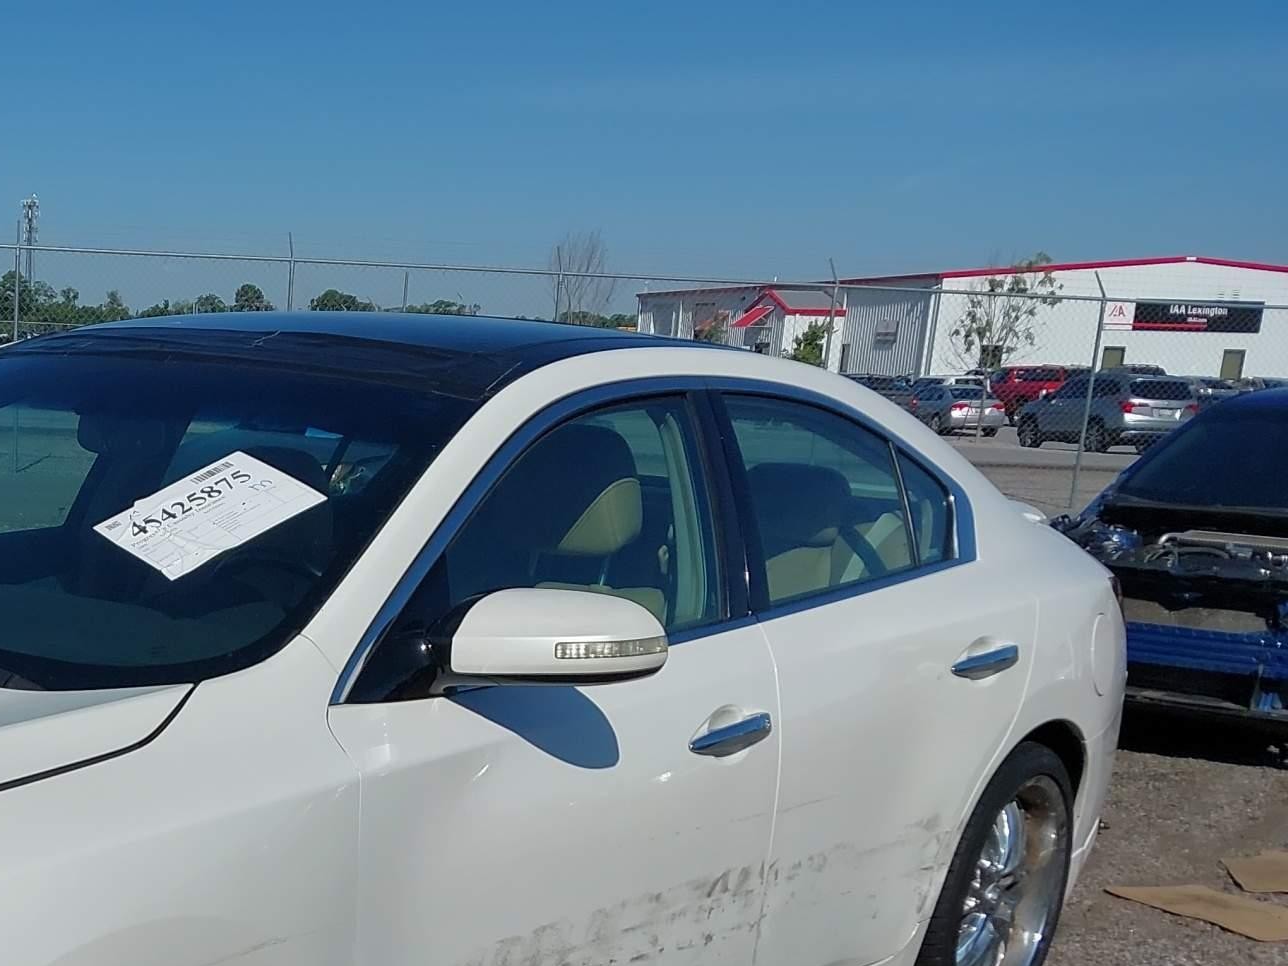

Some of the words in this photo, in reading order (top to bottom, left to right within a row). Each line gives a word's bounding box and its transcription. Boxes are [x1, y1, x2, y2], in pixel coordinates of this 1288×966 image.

[1169, 305, 1186, 315] IAA
[1187, 305, 1229, 317] Lexington
[131, 469, 251, 537] 45425875
